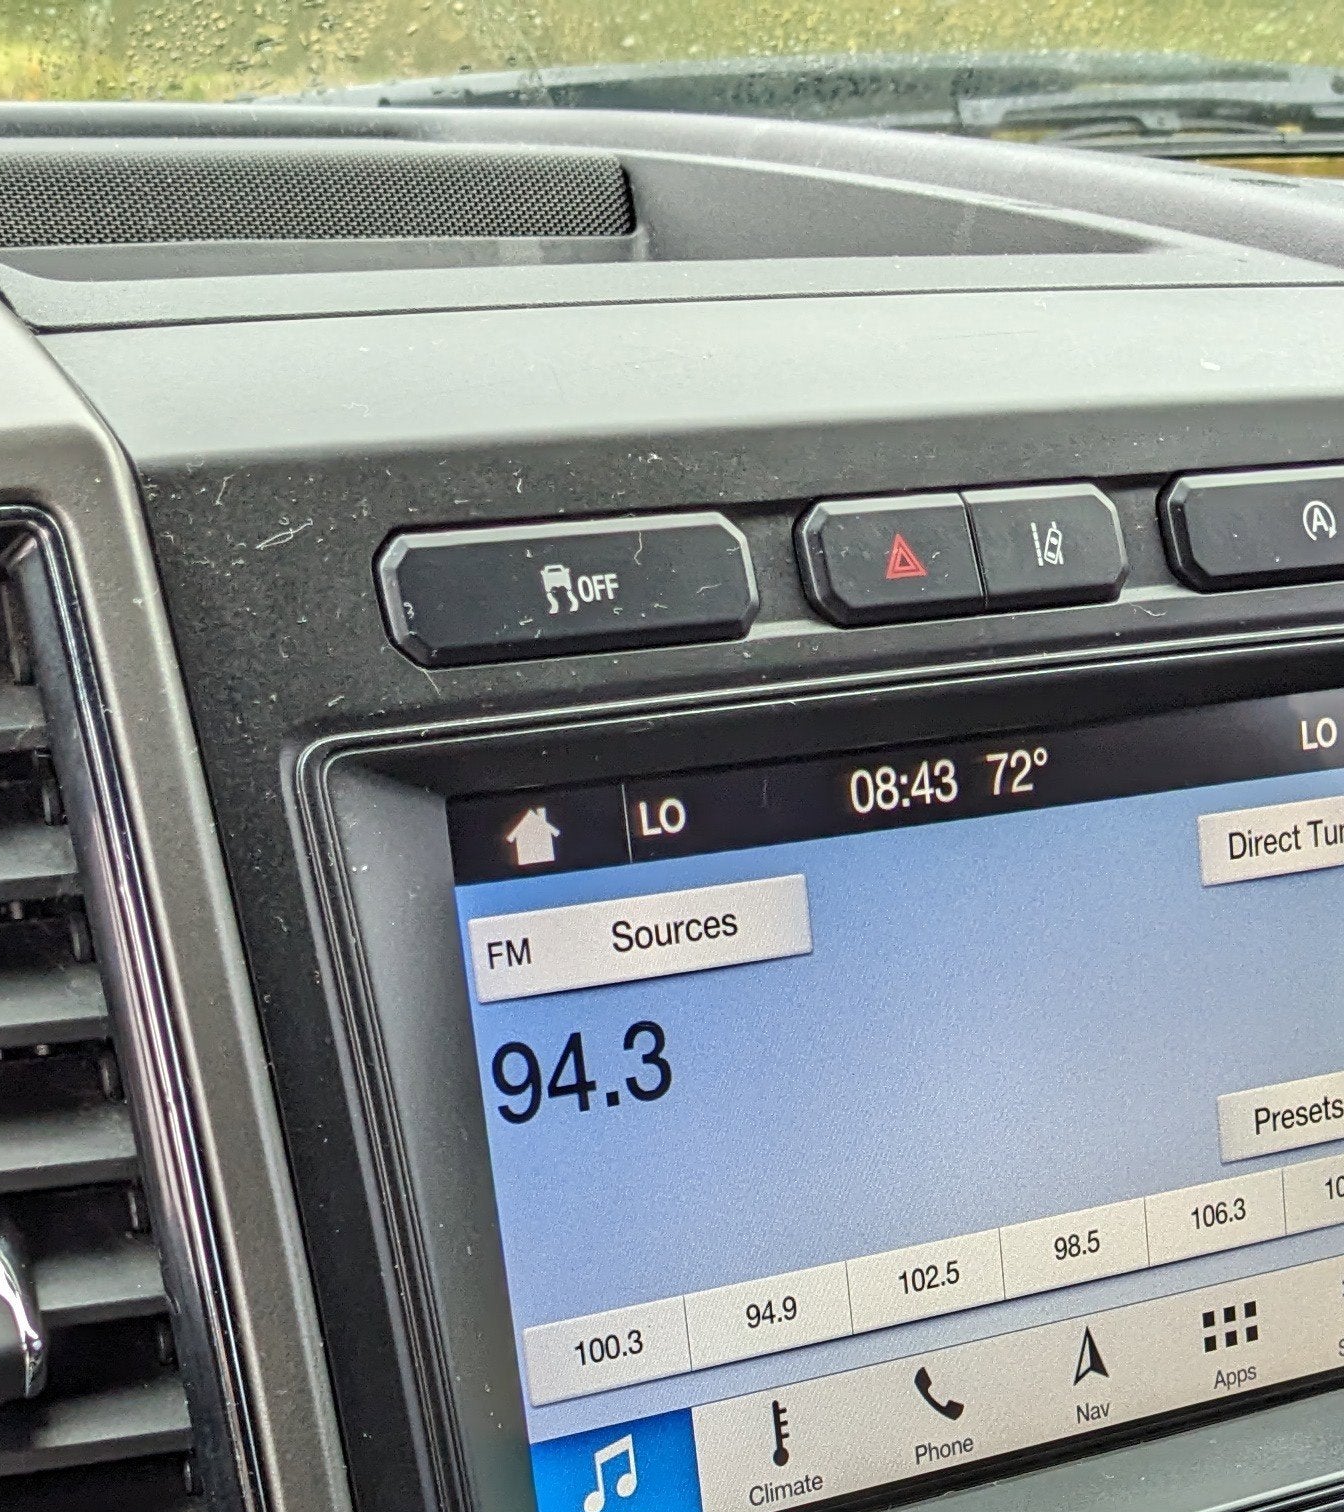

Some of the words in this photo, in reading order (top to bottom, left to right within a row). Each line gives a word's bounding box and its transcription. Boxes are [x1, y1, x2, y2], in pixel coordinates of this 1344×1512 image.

[576, 571, 619, 605] OFF
[1299, 715, 1337, 752] LO
[848, 760, 958, 815] 08:43
[640, 798, 687, 838] LO
[1226, 822, 1301, 861] Direct
[610, 908, 739, 956] Sources
[486, 937, 533, 971] FM
[491, 1019, 674, 1126] 94.3
[1252, 1092, 1344, 1137] Presets
[1188, 1196, 1247, 1231] 106.3
[1052, 1227, 1101, 1262] 98.5
[896, 1259, 960, 1295] 102.5
[744, 1294, 799, 1329] 94.9
[572, 1329, 645, 1368] 100.3
[1212, 1363, 1258, 1393] Apps
[1074, 1397, 1111, 1426] Nav
[913, 1432, 975, 1467] Phone
[747, 1468, 824, 1509] Climate
